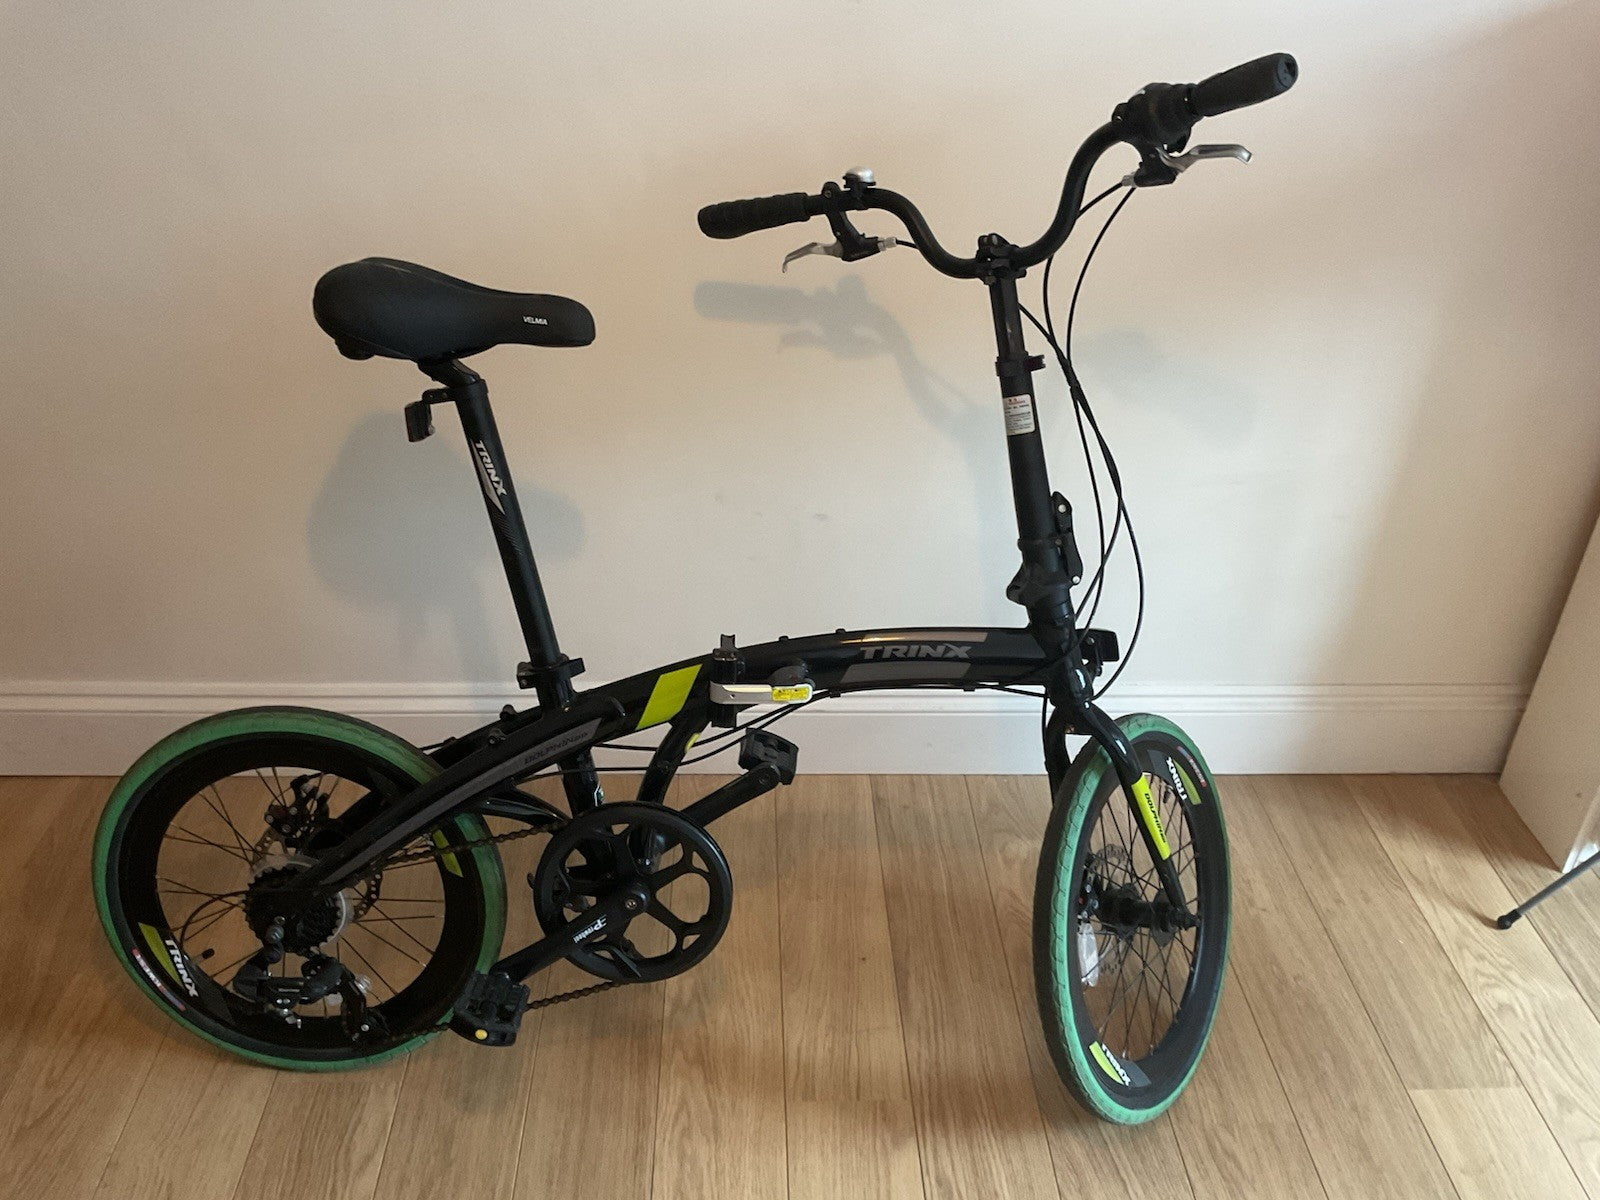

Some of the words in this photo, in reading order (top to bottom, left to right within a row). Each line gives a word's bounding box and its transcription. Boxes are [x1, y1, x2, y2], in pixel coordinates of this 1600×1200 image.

[475, 440, 508, 496] TRINX
[860, 643, 972, 660] TRINX
[1165, 756, 1188, 801] TRINX
[164, 939, 199, 997] TRINX
